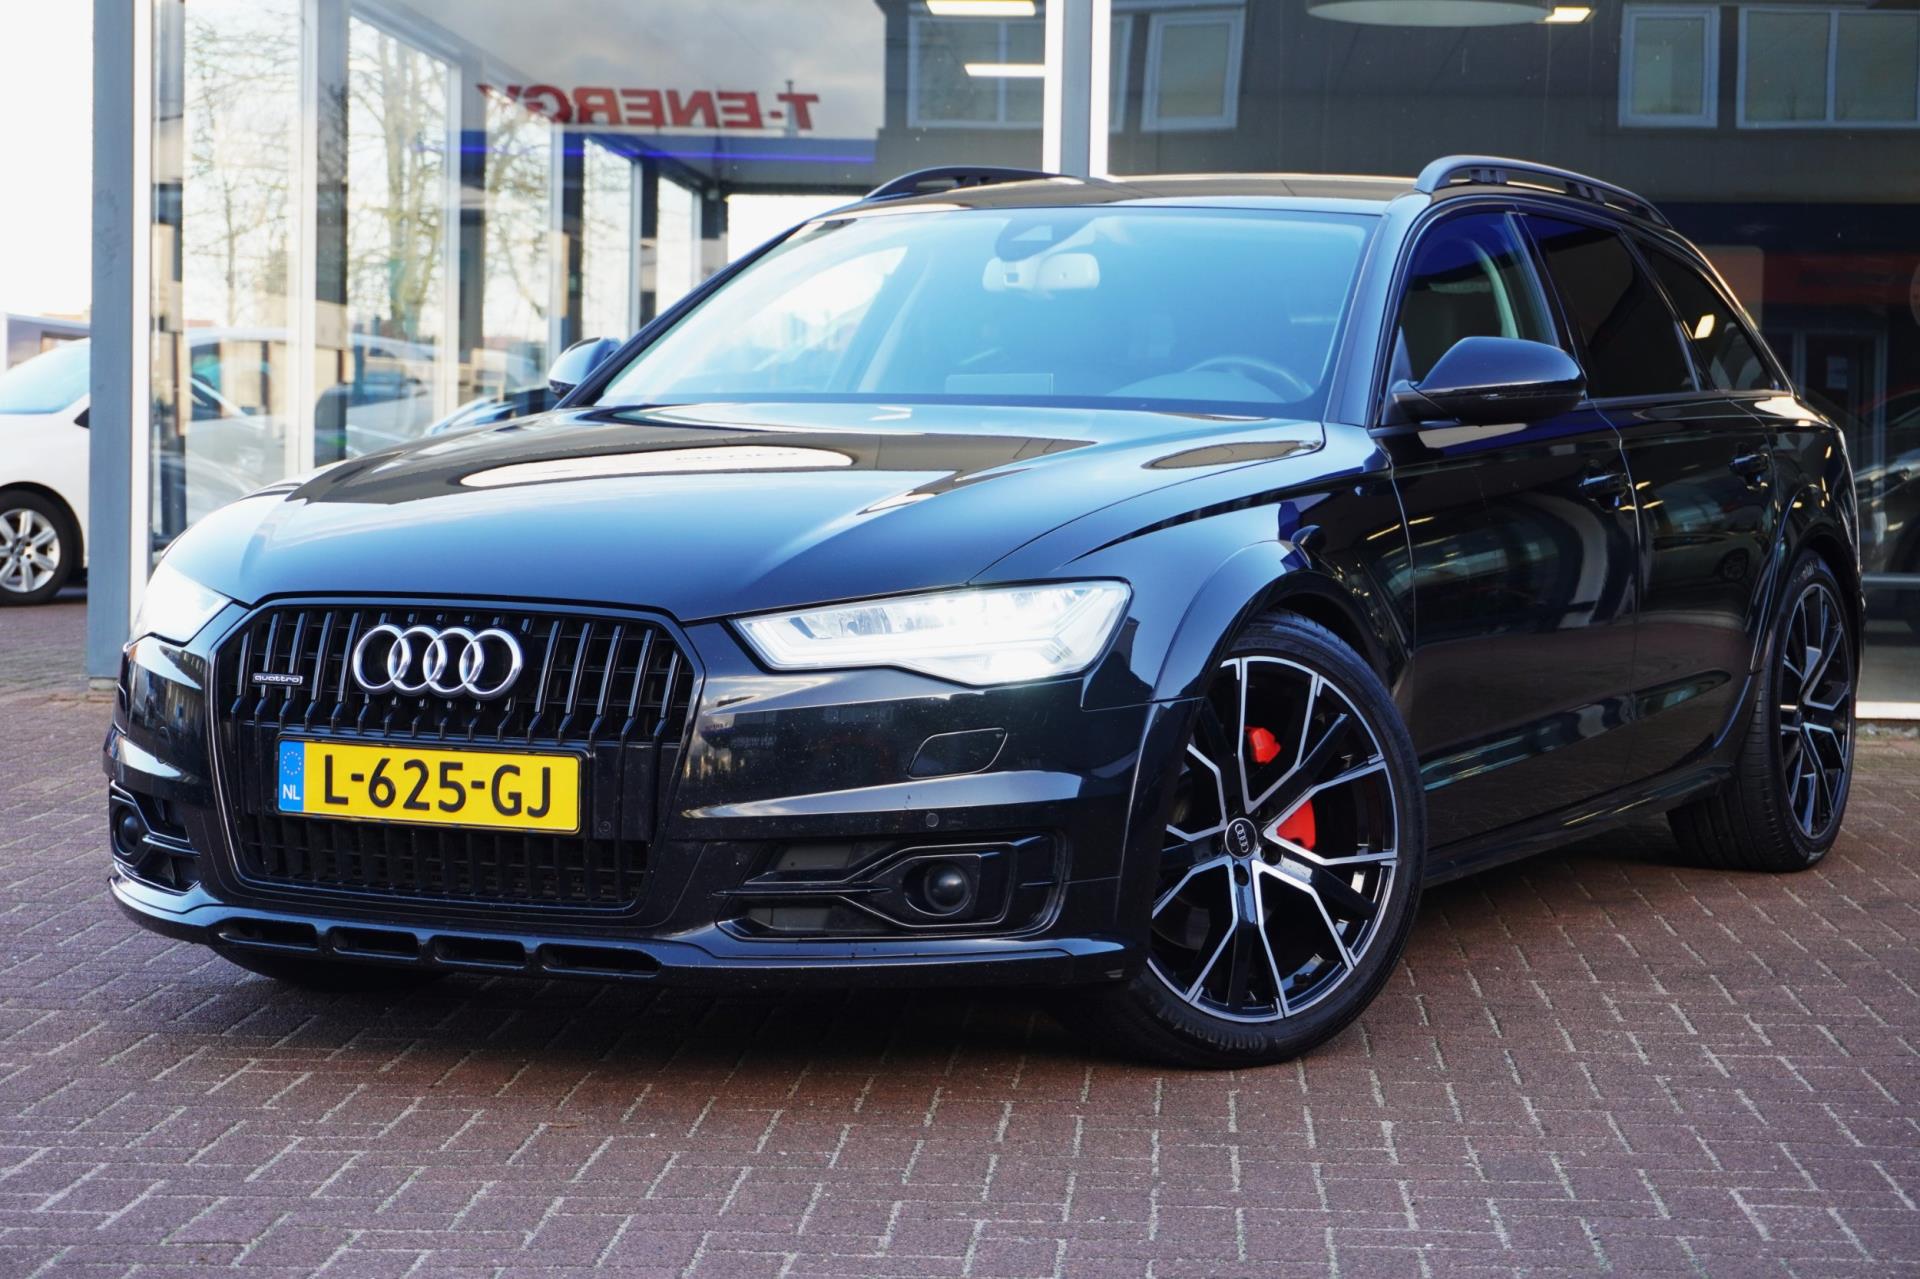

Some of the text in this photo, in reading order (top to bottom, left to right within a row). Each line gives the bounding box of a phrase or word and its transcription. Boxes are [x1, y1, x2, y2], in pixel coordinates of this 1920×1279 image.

[254, 674, 300, 683] quattro
[282, 784, 301, 800] NL
[324, 754, 551, 818] L-625-GJ
